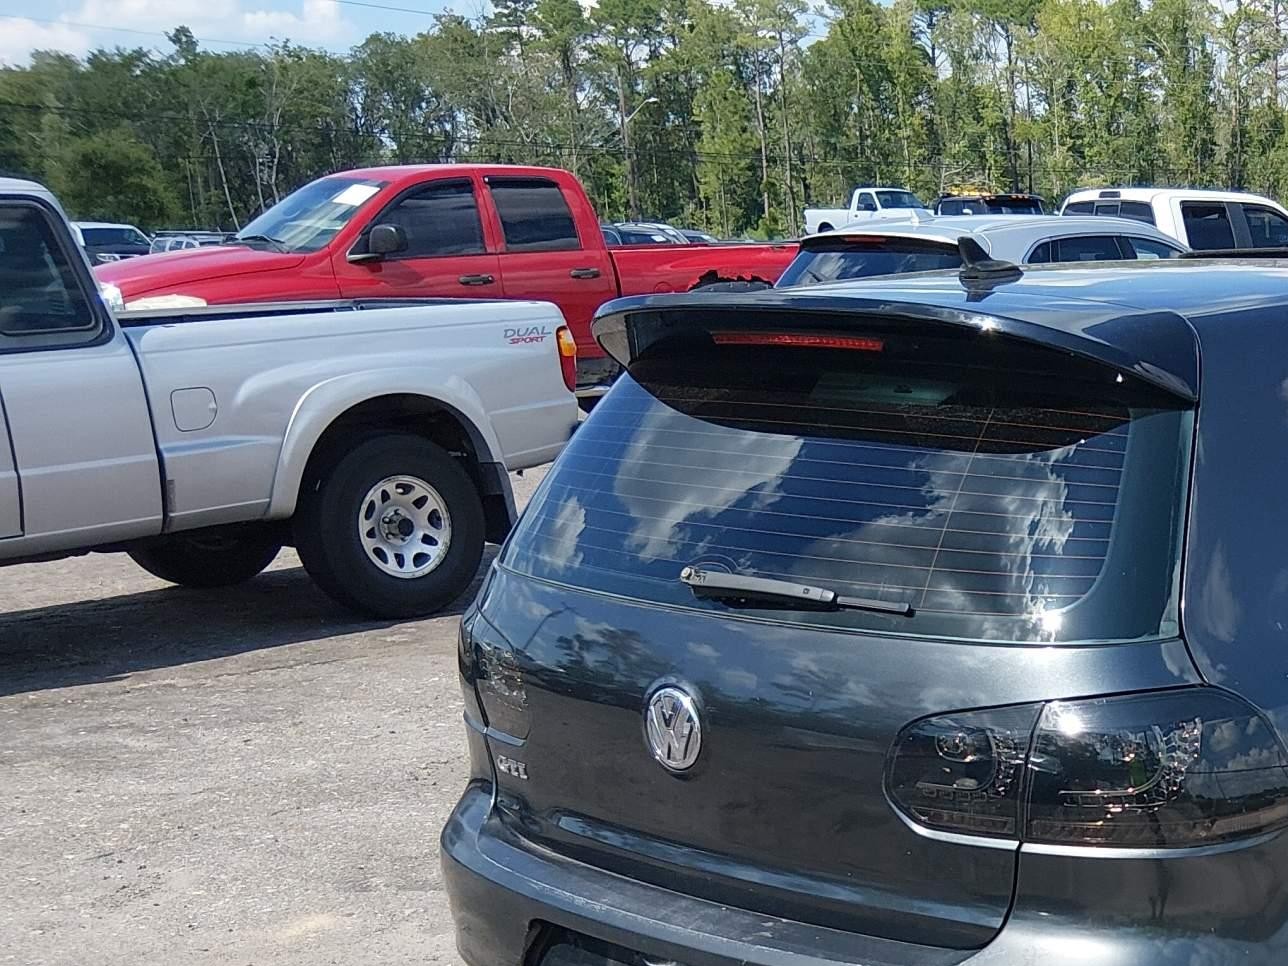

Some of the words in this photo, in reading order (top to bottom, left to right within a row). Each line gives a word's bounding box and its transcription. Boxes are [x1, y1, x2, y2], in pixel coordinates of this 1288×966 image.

[503, 326, 552, 339] DUAL
[509, 335, 546, 345] SPORT
[647, 688, 701, 770] VW
[497, 754, 529, 780] GTI
